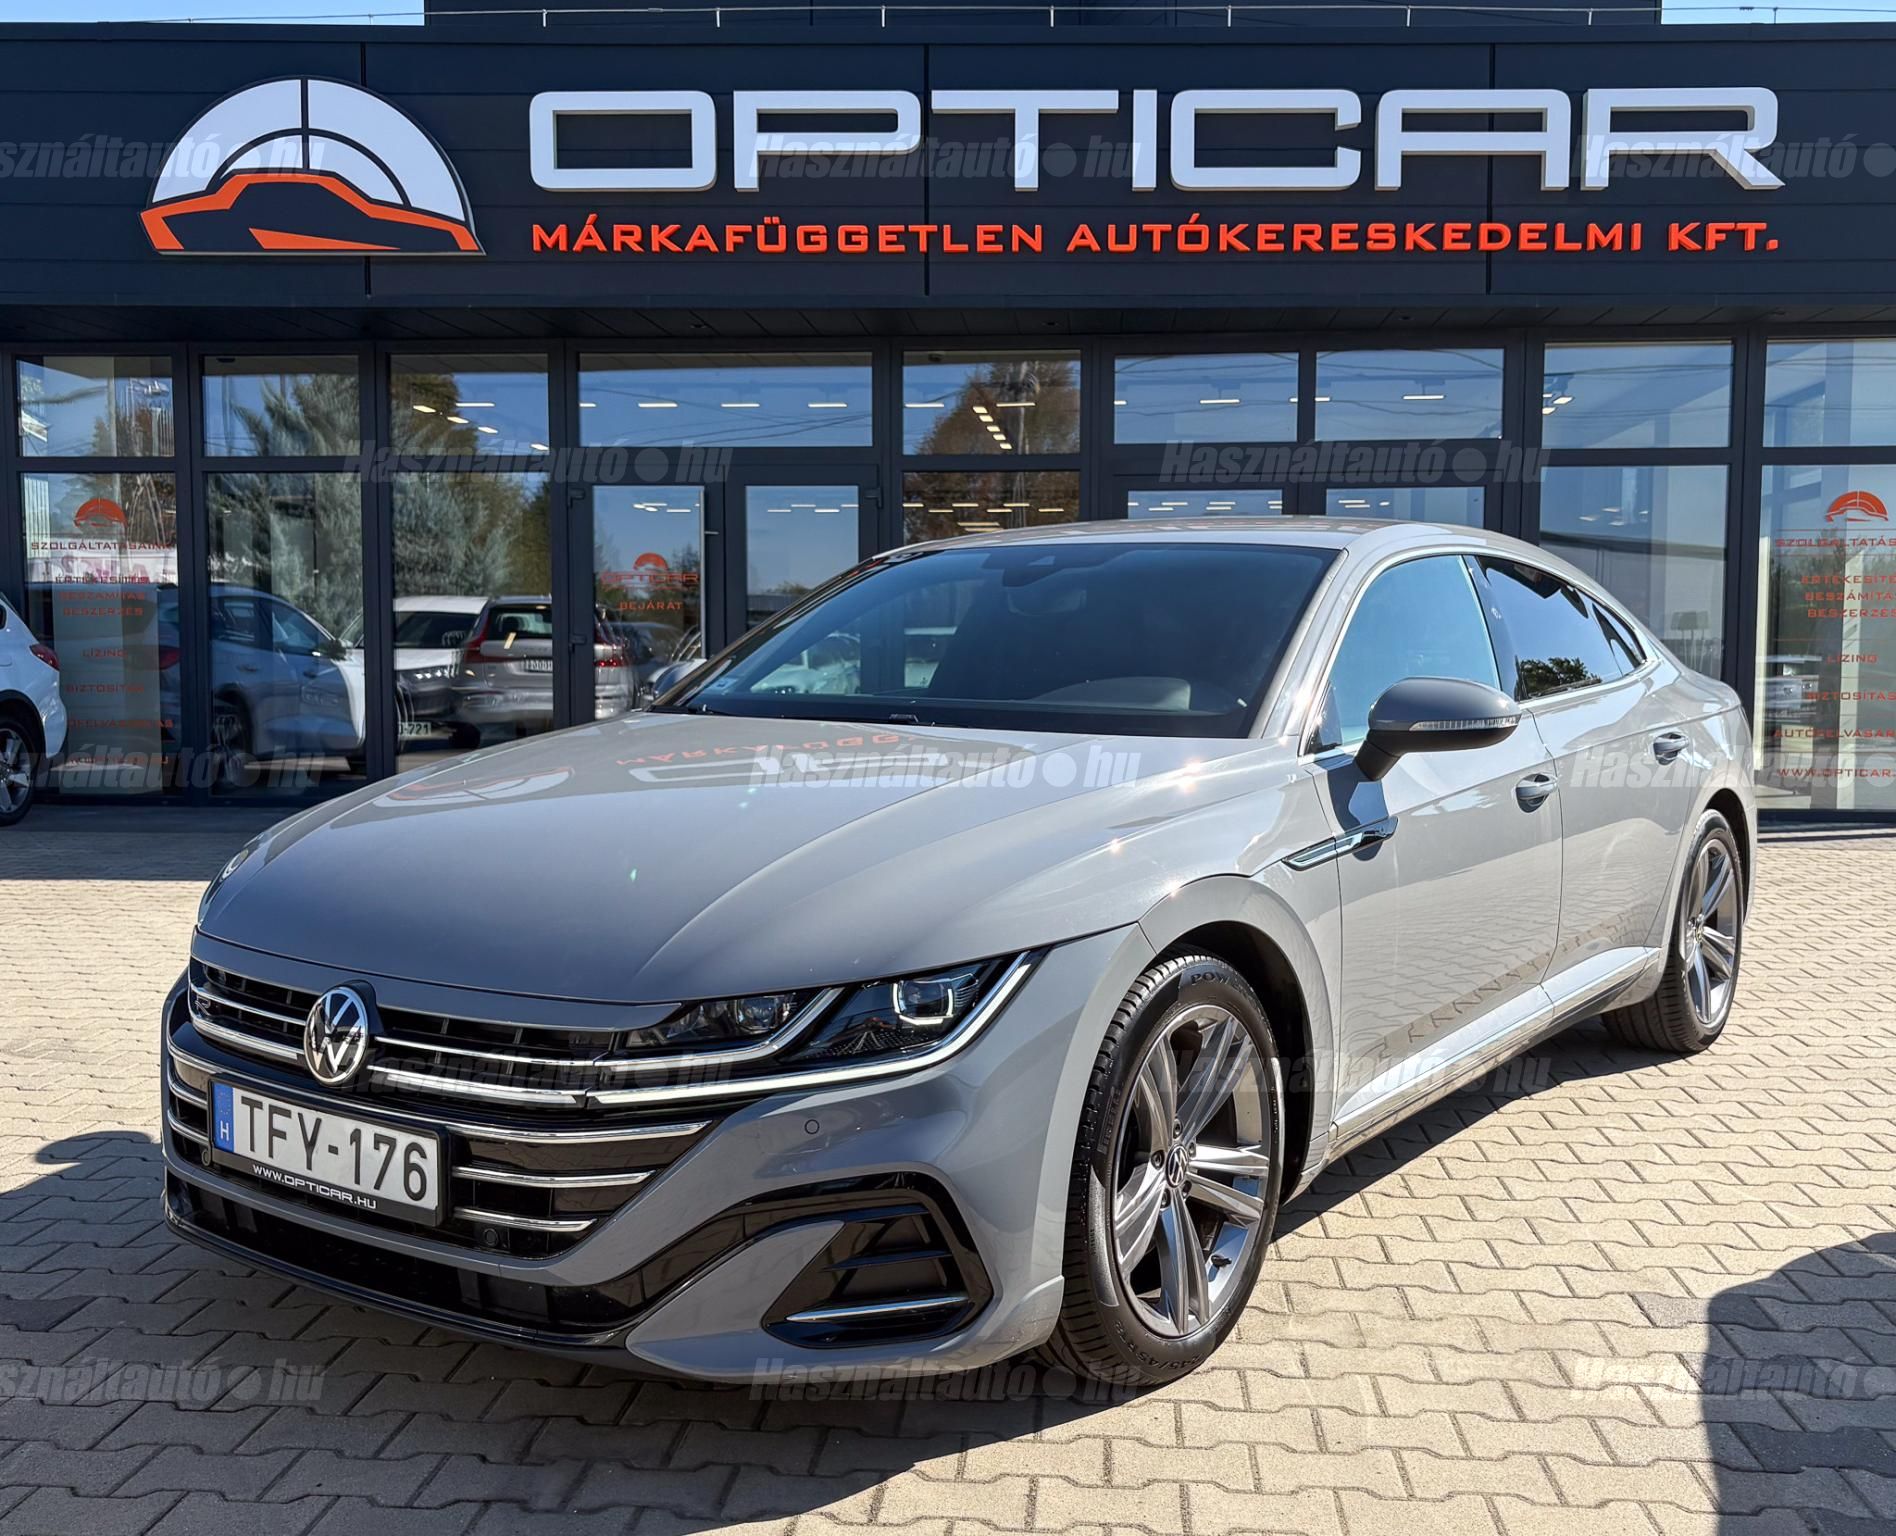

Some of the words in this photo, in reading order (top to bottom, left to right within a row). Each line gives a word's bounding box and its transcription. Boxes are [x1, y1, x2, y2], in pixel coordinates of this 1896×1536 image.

[529, 87, 1785, 193] OPTICAR
[532, 212, 1043, 253] MÁRKAFÜGGETLEN
[1066, 212, 1643, 253] AUTÓKERESKEDELMI
[1668, 220, 1780, 251] KFT.
[240, 1095, 428, 1202] TFY-176
[252, 1163, 377, 1210] WWW.OPTICAR.HU
